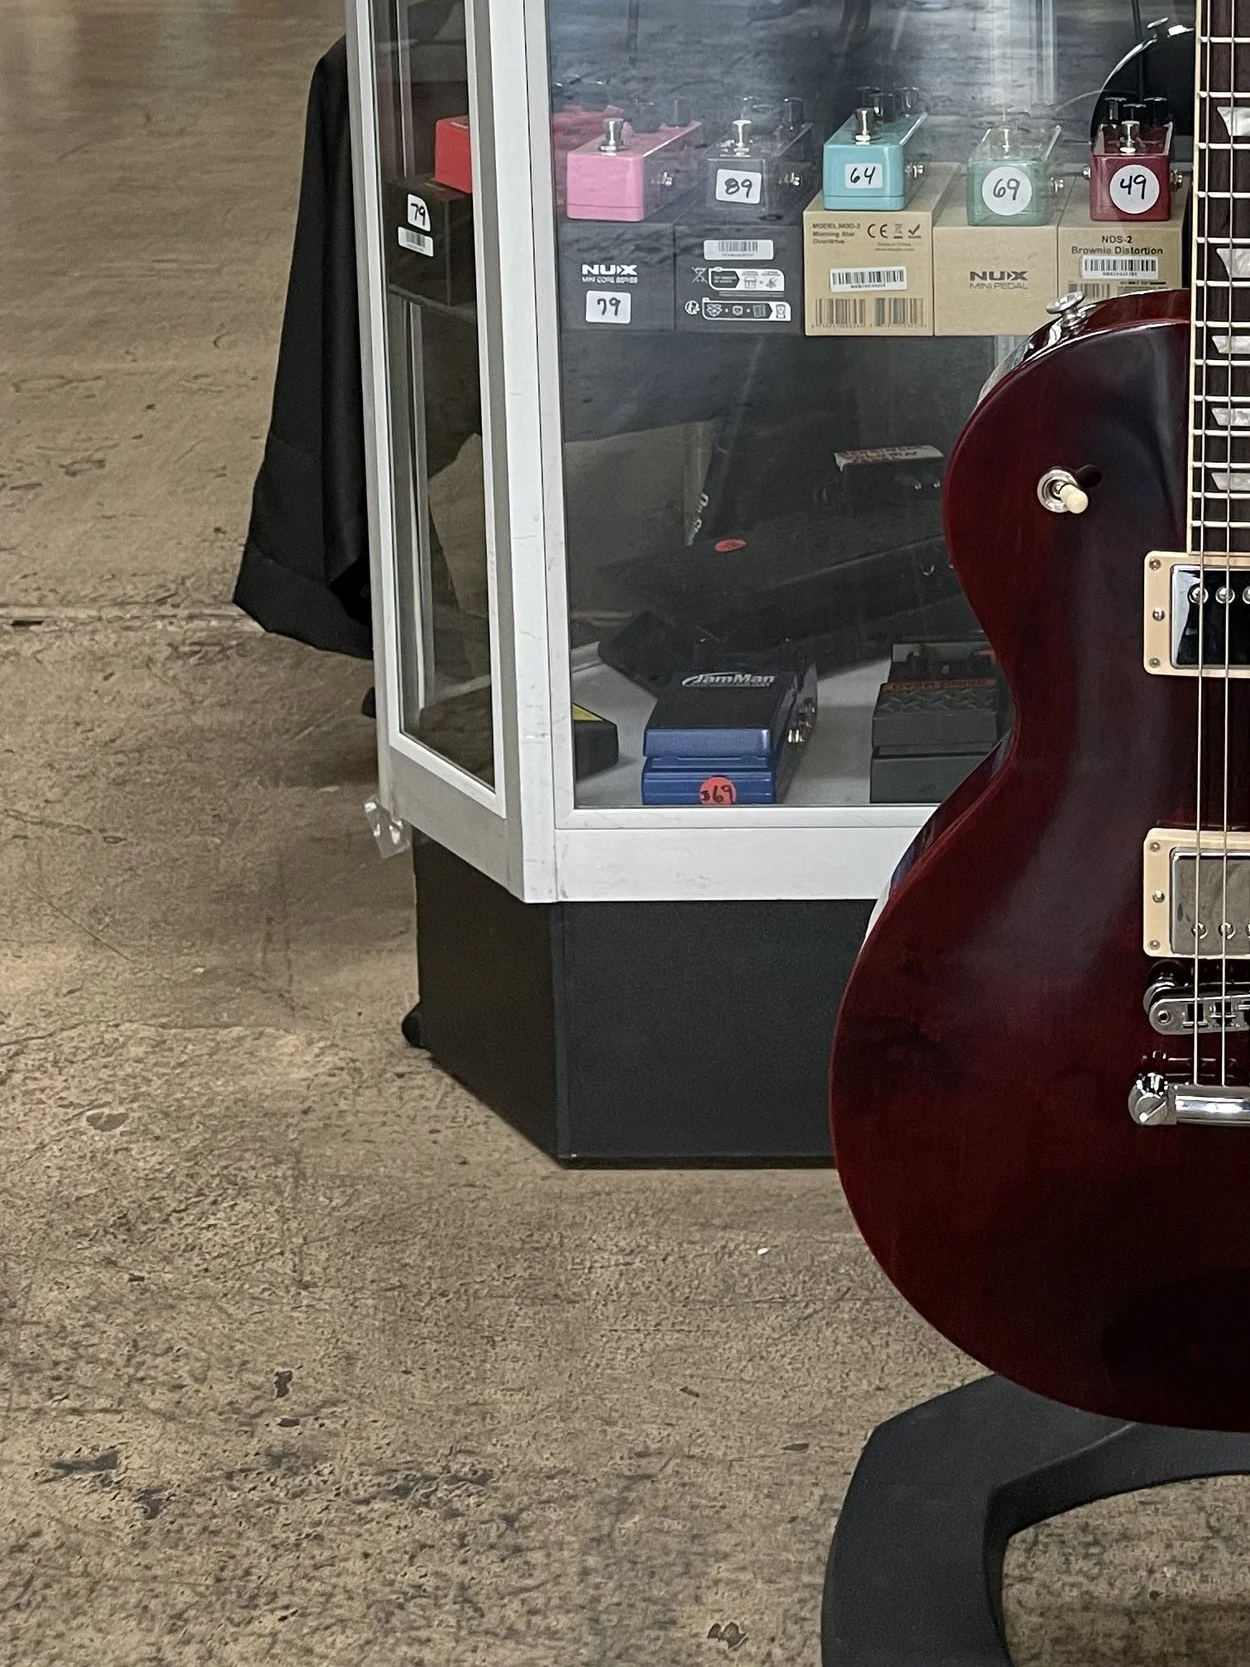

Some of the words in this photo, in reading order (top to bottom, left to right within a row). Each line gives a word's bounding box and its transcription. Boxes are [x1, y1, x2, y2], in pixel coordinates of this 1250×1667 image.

[849, 165, 877, 186] 64
[723, 177, 753, 199] 89
[993, 177, 1022, 201] 69
[1119, 174, 1148, 201] 49
[410, 202, 427, 227] 79
[1101, 235, 1133, 244] NDS-2
[1071, 245, 1112, 255] Brownie
[1114, 245, 1164, 255] Distortion
[581, 263, 639, 276] NUX
[969, 270, 1029, 282] NUX
[969, 281, 994, 290] MINI
[994, 281, 1029, 291] PEDAL
[596, 296, 622, 317] 79
[692, 673, 776, 686] JamMan
